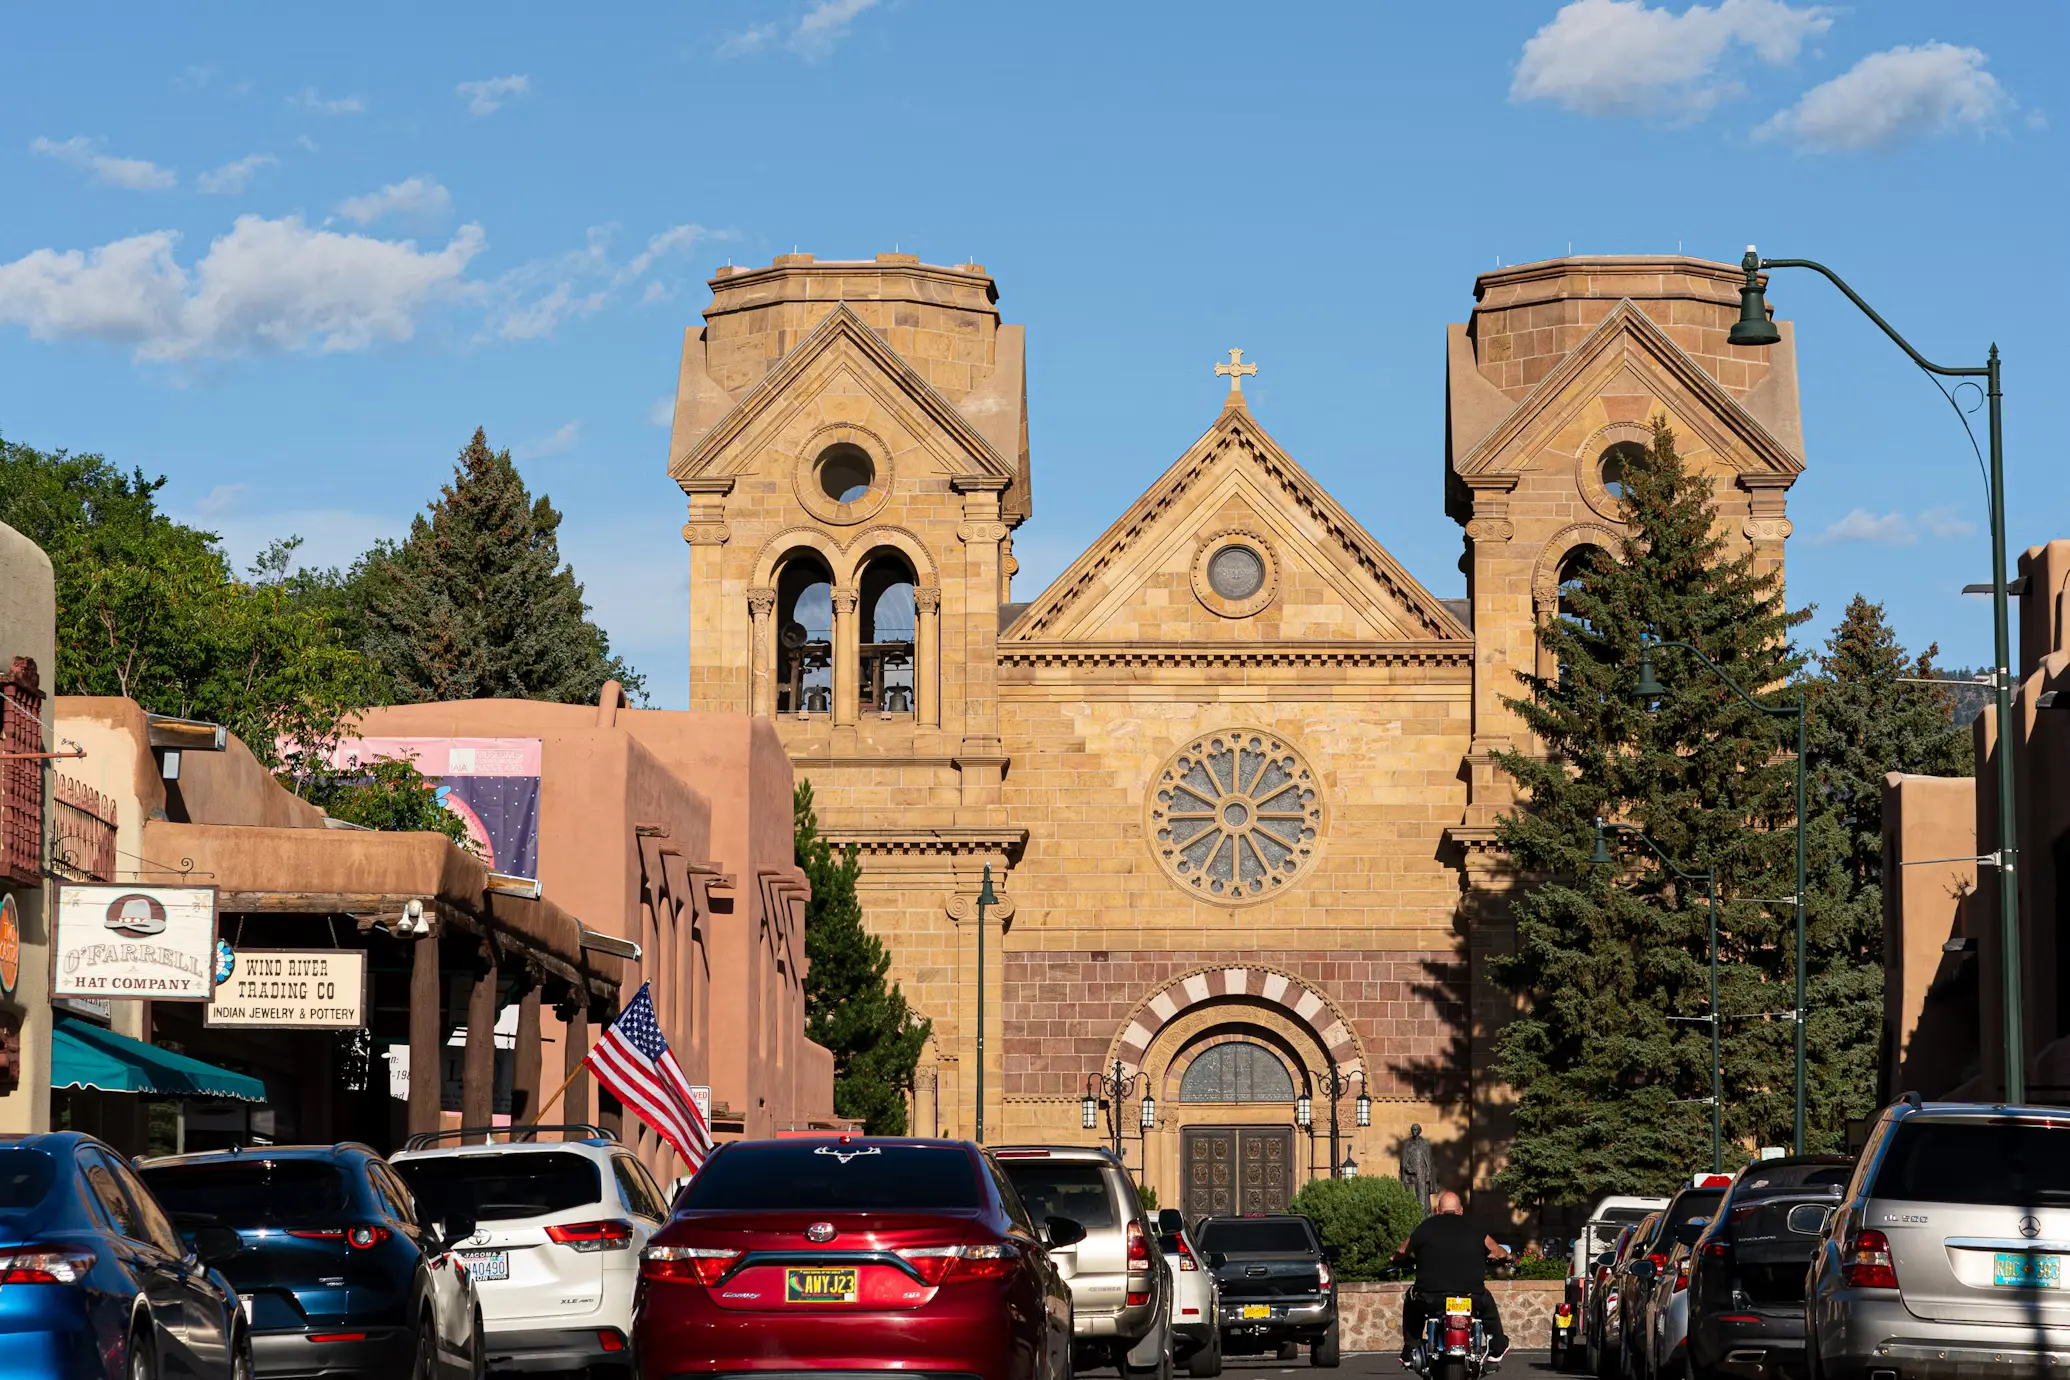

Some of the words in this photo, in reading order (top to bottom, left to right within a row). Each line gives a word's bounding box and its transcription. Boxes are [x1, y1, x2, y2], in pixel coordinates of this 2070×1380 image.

[63, 943, 204, 978] O'FARRELL
[246, 959, 282, 976] WIND
[288, 959, 328, 977] RIVER
[75, 977, 107, 988] HAT
[112, 978, 191, 990] COMPANY
[238, 981, 308, 1000] TRADING
[317, 982, 335, 1000] CO
[213, 1007, 246, 1018] INDIAN
[249, 1007, 295, 1019] JEWELRY
[299, 1008, 306, 1019] &
[310, 1008, 355, 1020] POTTERY
[2036, 1261, 2059, 1279] 383
[805, 1275, 854, 1293] AWYJ23
